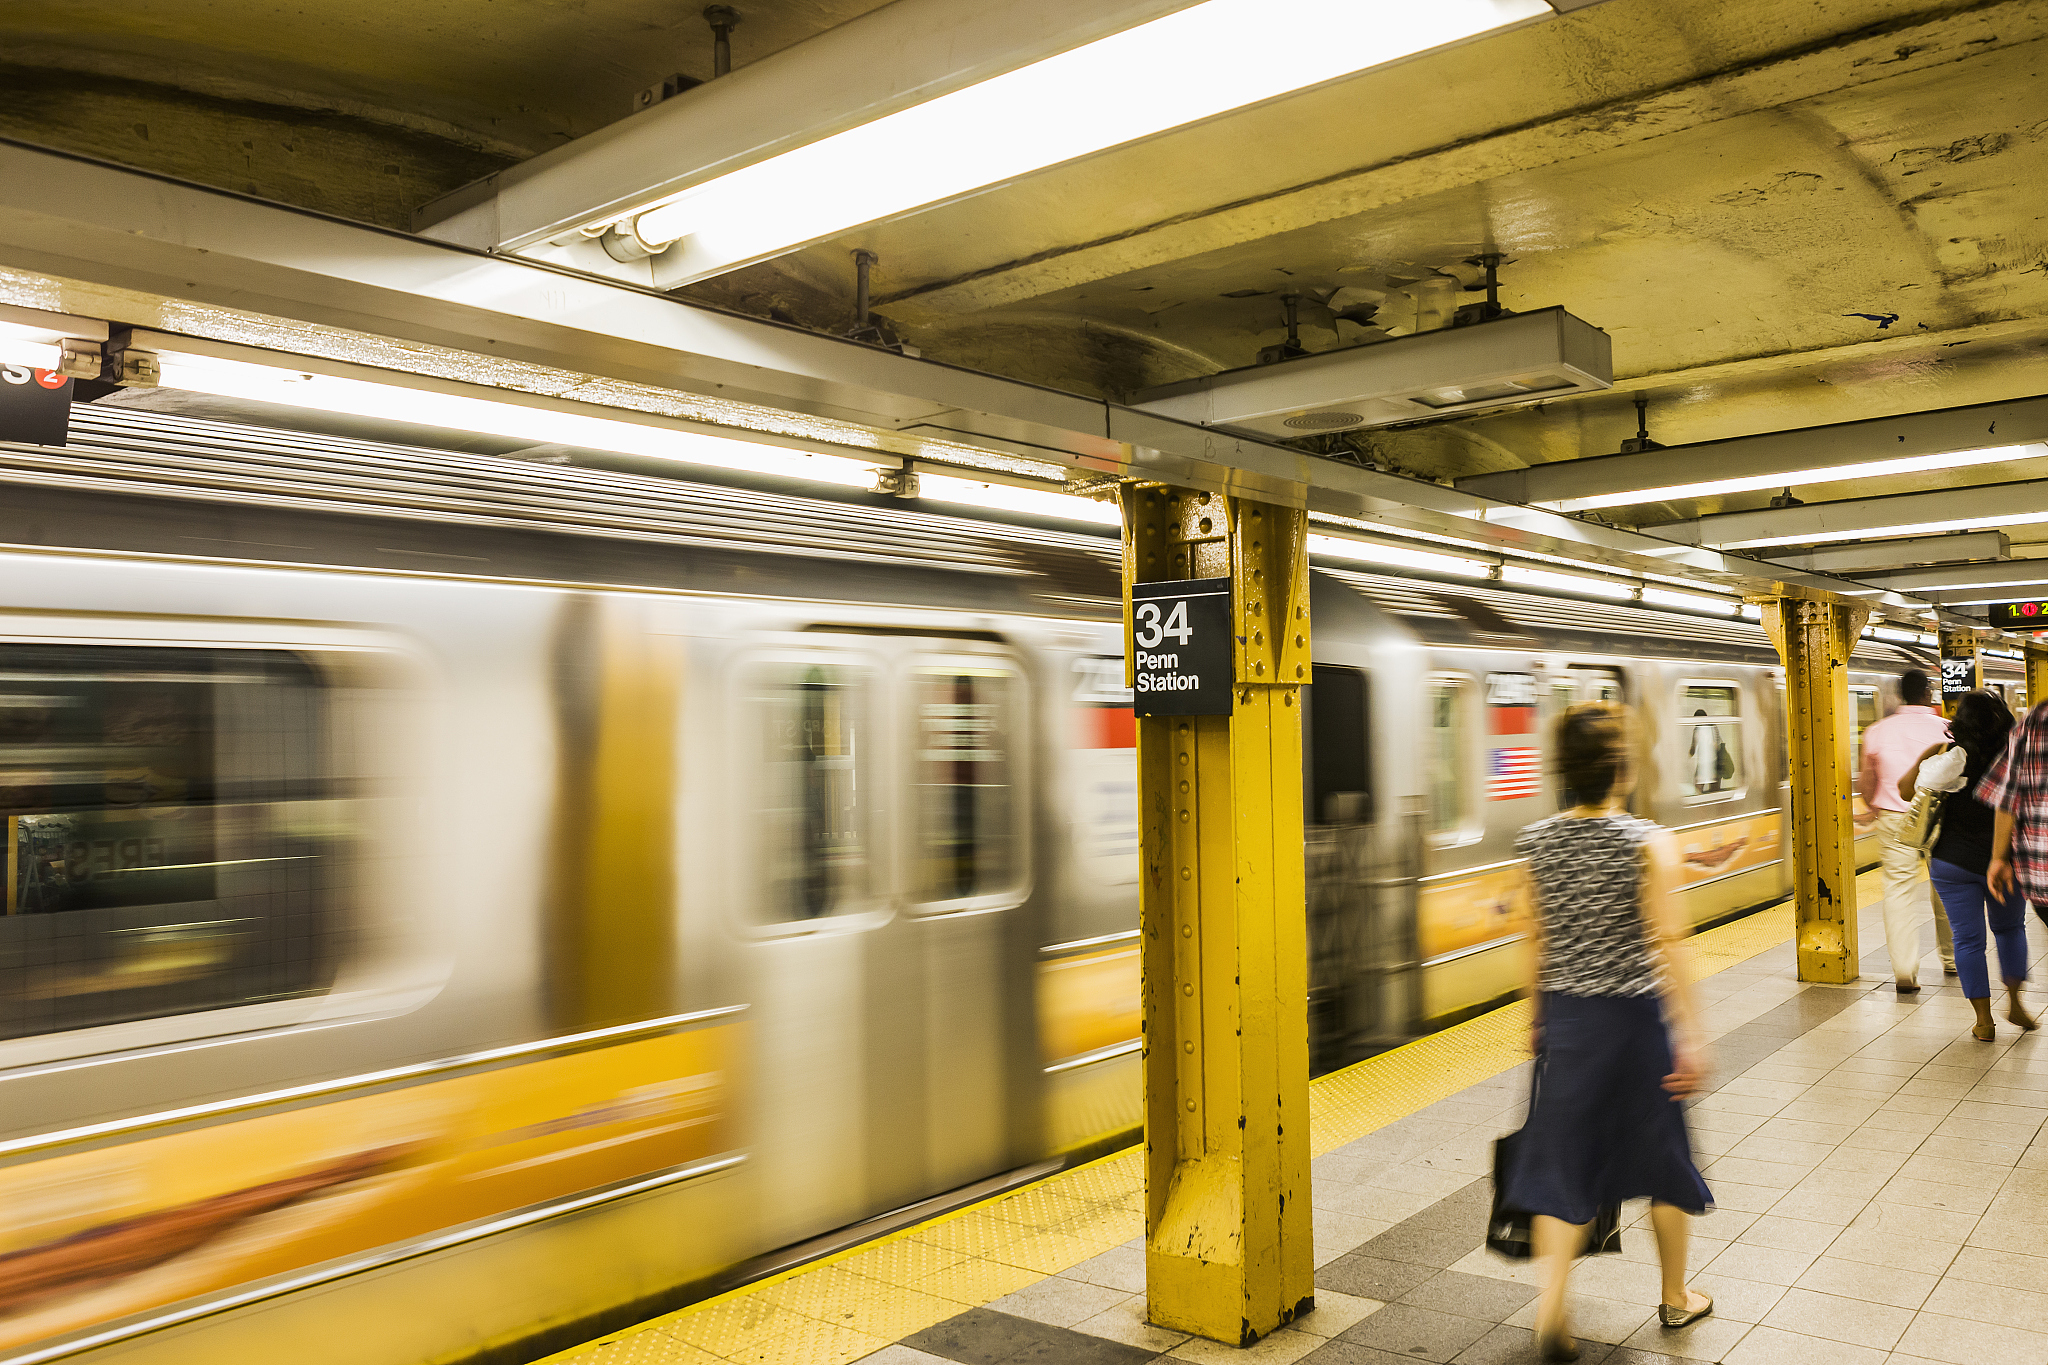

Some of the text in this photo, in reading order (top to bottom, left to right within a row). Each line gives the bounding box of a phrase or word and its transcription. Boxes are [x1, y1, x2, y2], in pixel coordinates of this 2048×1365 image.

[1135, 601, 1193, 649] 34
[1136, 651, 1179, 670] Penn
[1941, 662, 1969, 679] 34
[1136, 671, 1200, 693] Station
[1942, 678, 1963, 686] Penn
[1943, 685, 1972, 693] Station
